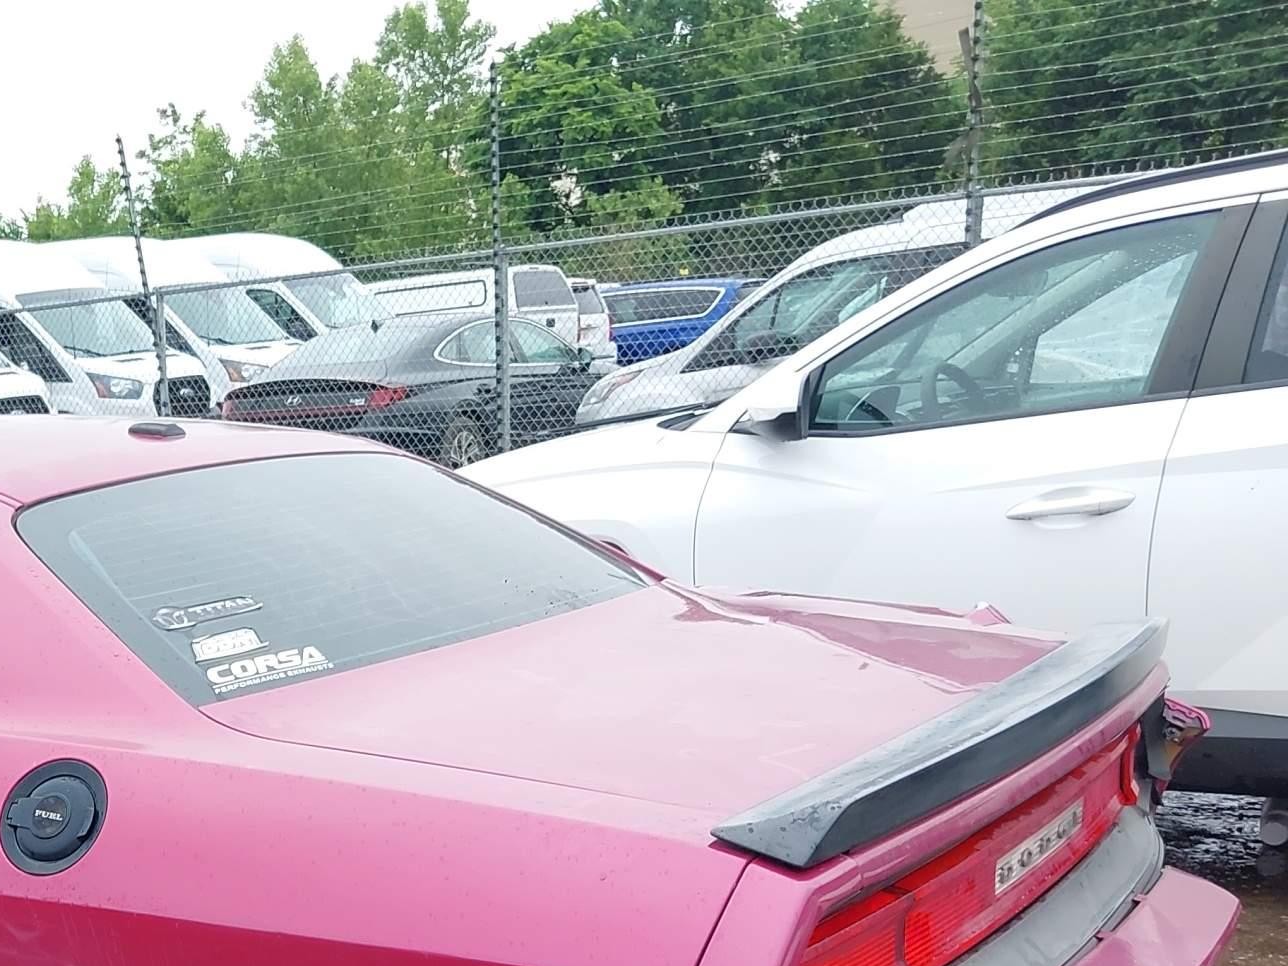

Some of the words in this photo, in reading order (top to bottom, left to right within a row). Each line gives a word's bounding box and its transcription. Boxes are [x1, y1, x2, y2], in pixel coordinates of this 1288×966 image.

[207, 645, 327, 685] CORSA
[214, 672, 287, 695] PERFORMANCE
[287, 663, 334, 678] EXHAUSTS
[34, 809, 63, 821] FUEL
